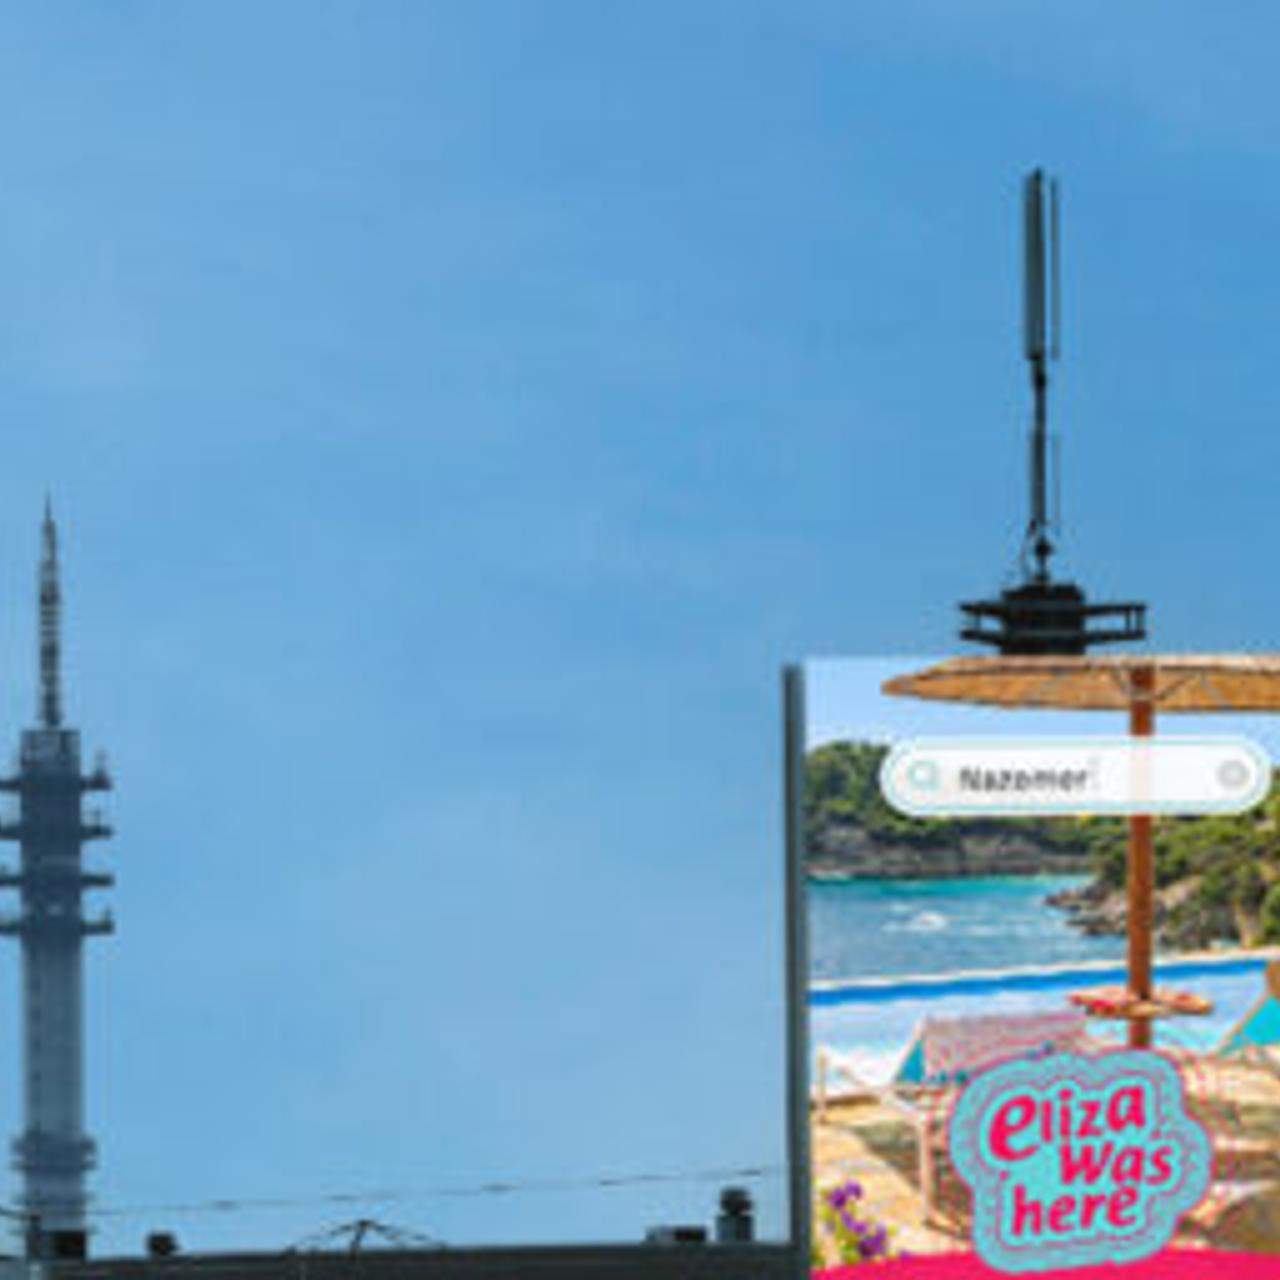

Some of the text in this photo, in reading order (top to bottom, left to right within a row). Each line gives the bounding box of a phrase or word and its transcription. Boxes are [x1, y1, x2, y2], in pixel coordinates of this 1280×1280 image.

[958, 764, 1087, 792] Nazomer
[989, 1085, 1145, 1161] eliza
[1061, 1140, 1173, 1186] was
[1012, 1184, 1139, 1236] here
